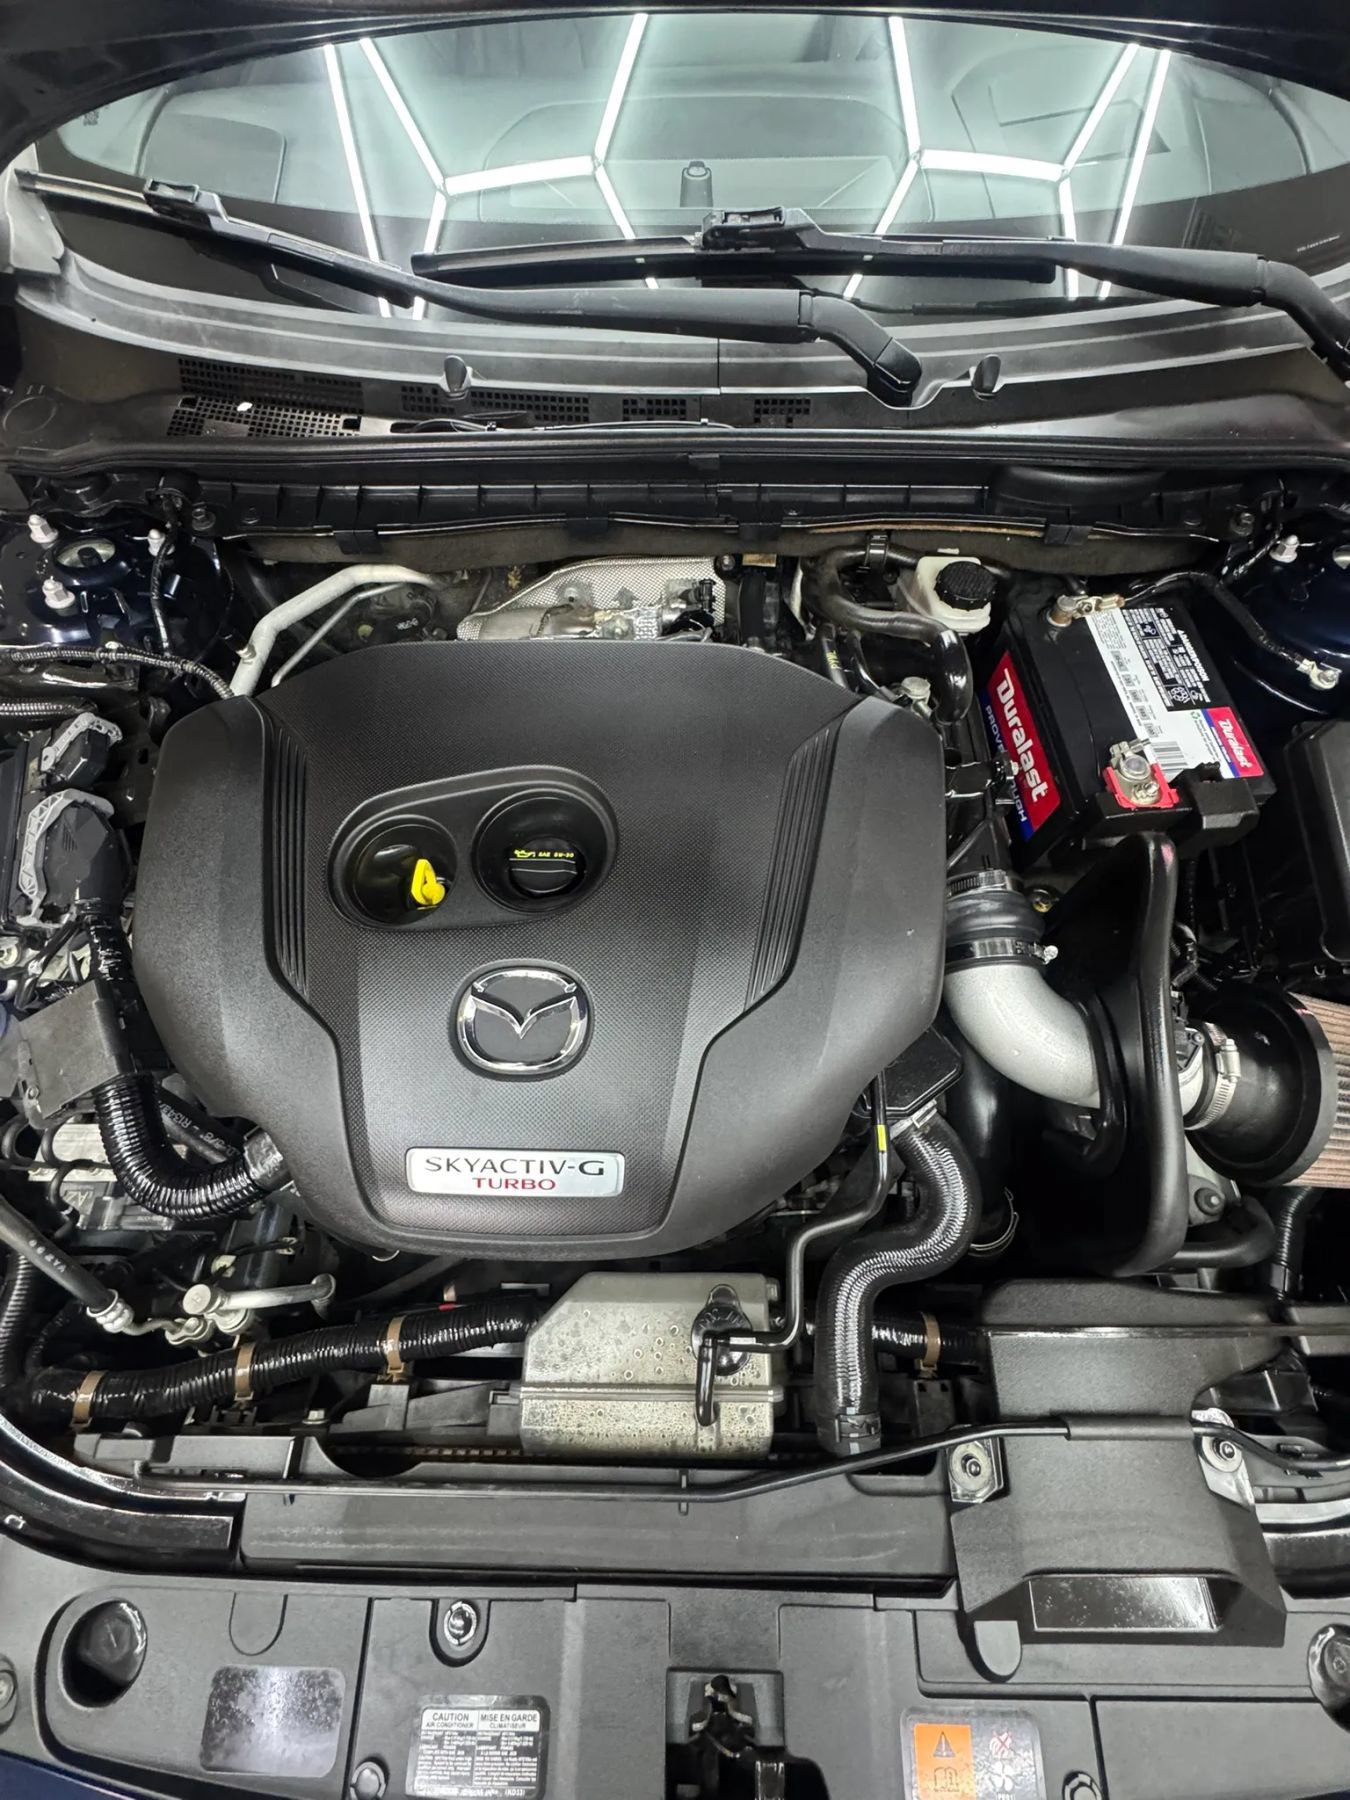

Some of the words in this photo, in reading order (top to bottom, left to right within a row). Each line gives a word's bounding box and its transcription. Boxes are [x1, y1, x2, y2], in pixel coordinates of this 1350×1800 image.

[985, 706, 1008, 753] PROVE
[996, 667, 1049, 803] Duralast
[1218, 718, 1253, 768] Duralast
[425, 1156, 605, 1176] SKYACTIV-G
[473, 1177, 556, 1191] TURBO
[432, 1712, 470, 1722] CAUTION
[436, 1721, 474, 1729] CONDITIONER
[480, 1713, 498, 1722] MISE
[500, 1713, 510, 1722] EN
[511, 1713, 538, 1722] GARDE
